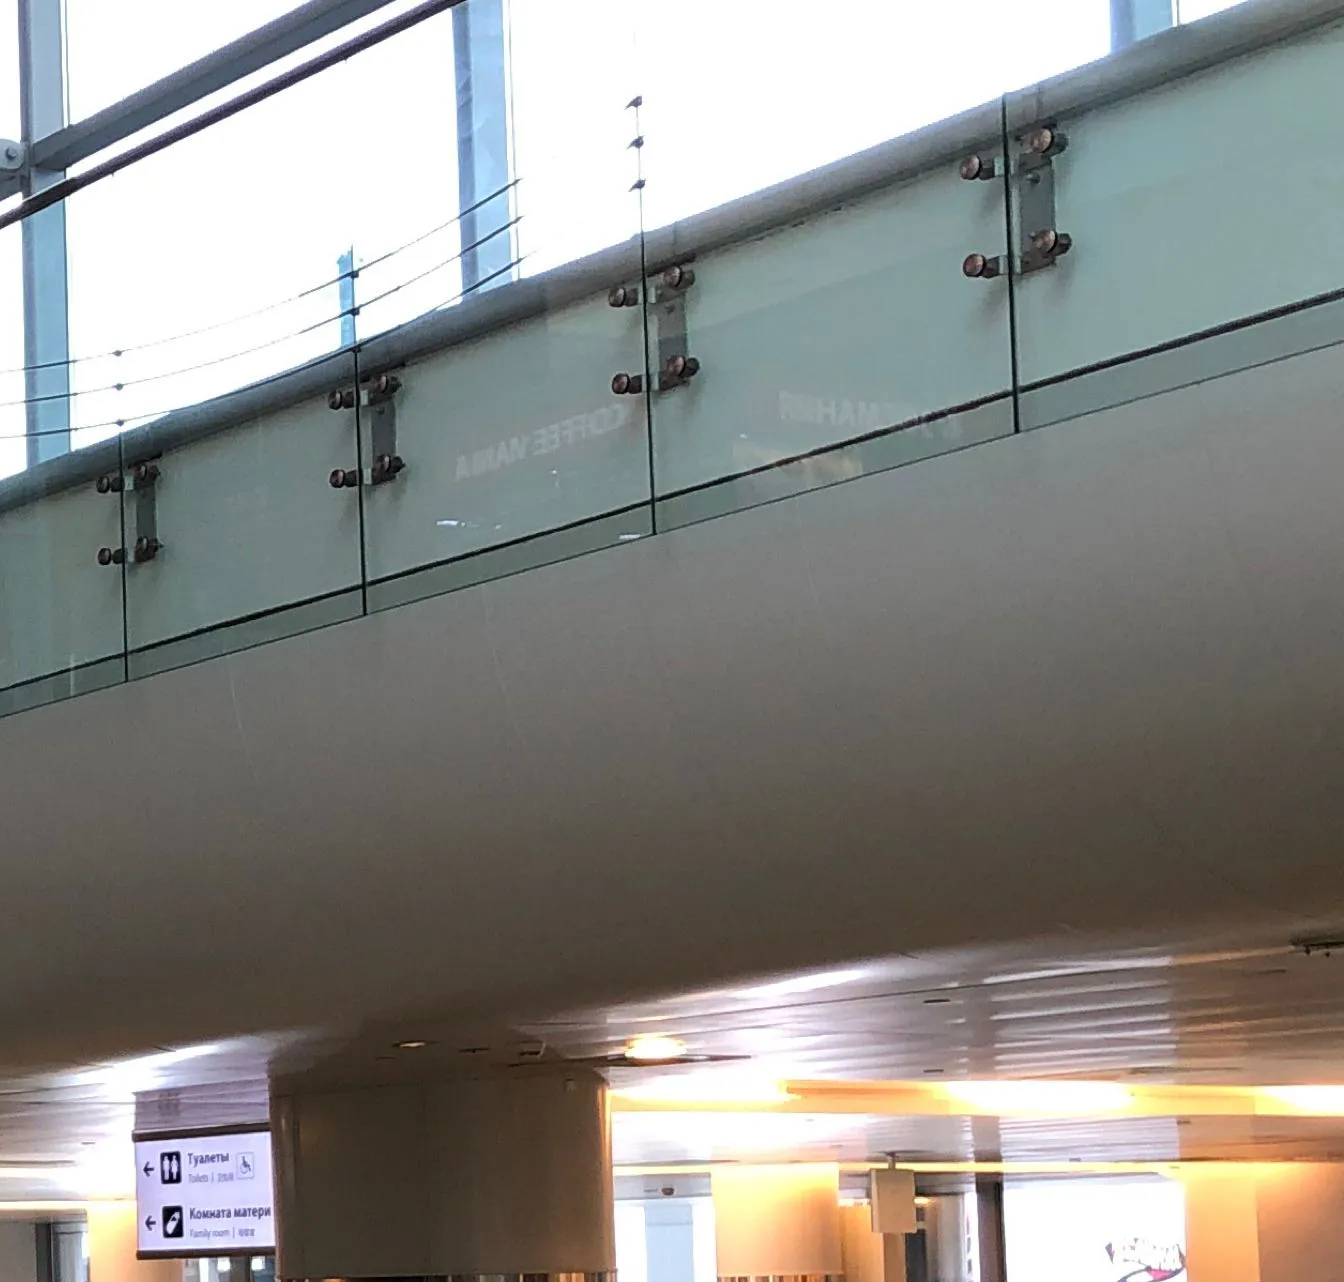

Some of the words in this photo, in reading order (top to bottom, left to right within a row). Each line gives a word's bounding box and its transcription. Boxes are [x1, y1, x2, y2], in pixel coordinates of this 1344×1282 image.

[187, 1152, 229, 1168] Туалеты
[189, 1207, 231, 1219] Комната
[233, 1206, 271, 1220] матери
